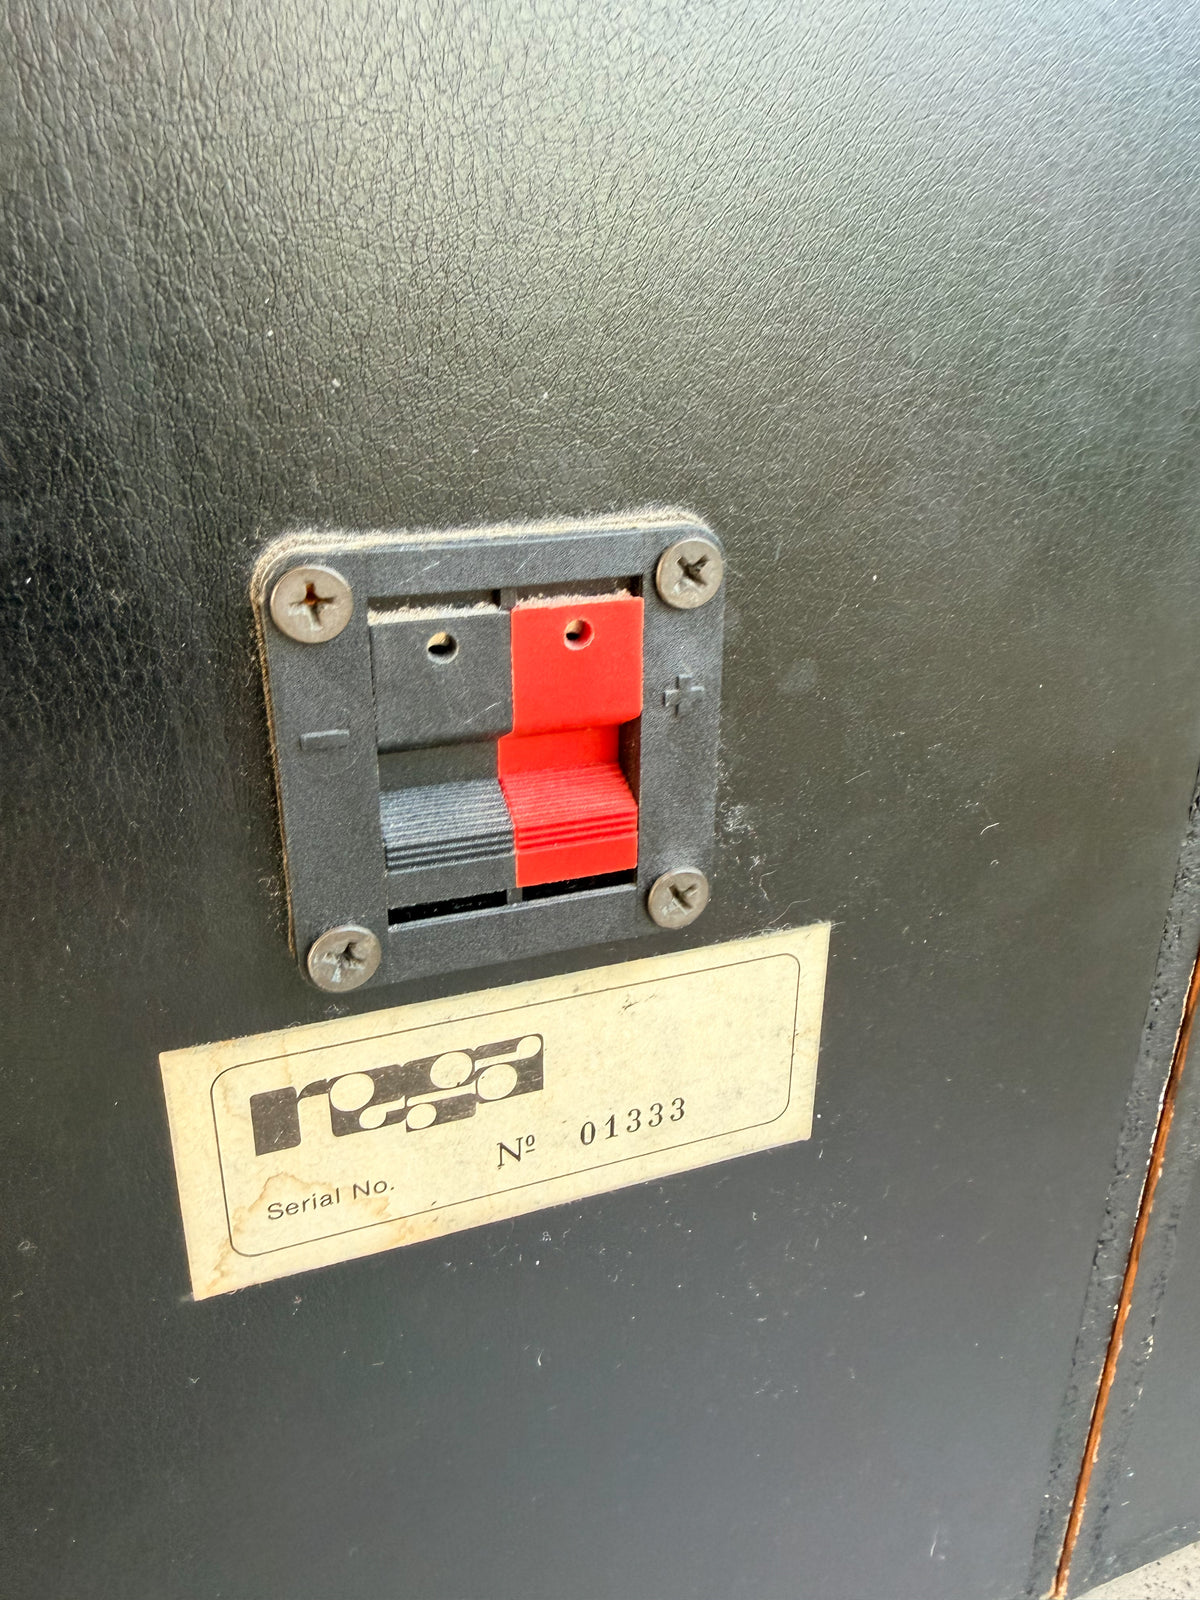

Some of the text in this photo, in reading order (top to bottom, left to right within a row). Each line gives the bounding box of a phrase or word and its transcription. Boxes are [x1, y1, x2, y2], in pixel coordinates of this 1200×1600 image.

[267, 1187, 341, 1220] Serial
[352, 1179, 395, 1201] No.
[580, 1097, 686, 1146] 01333
